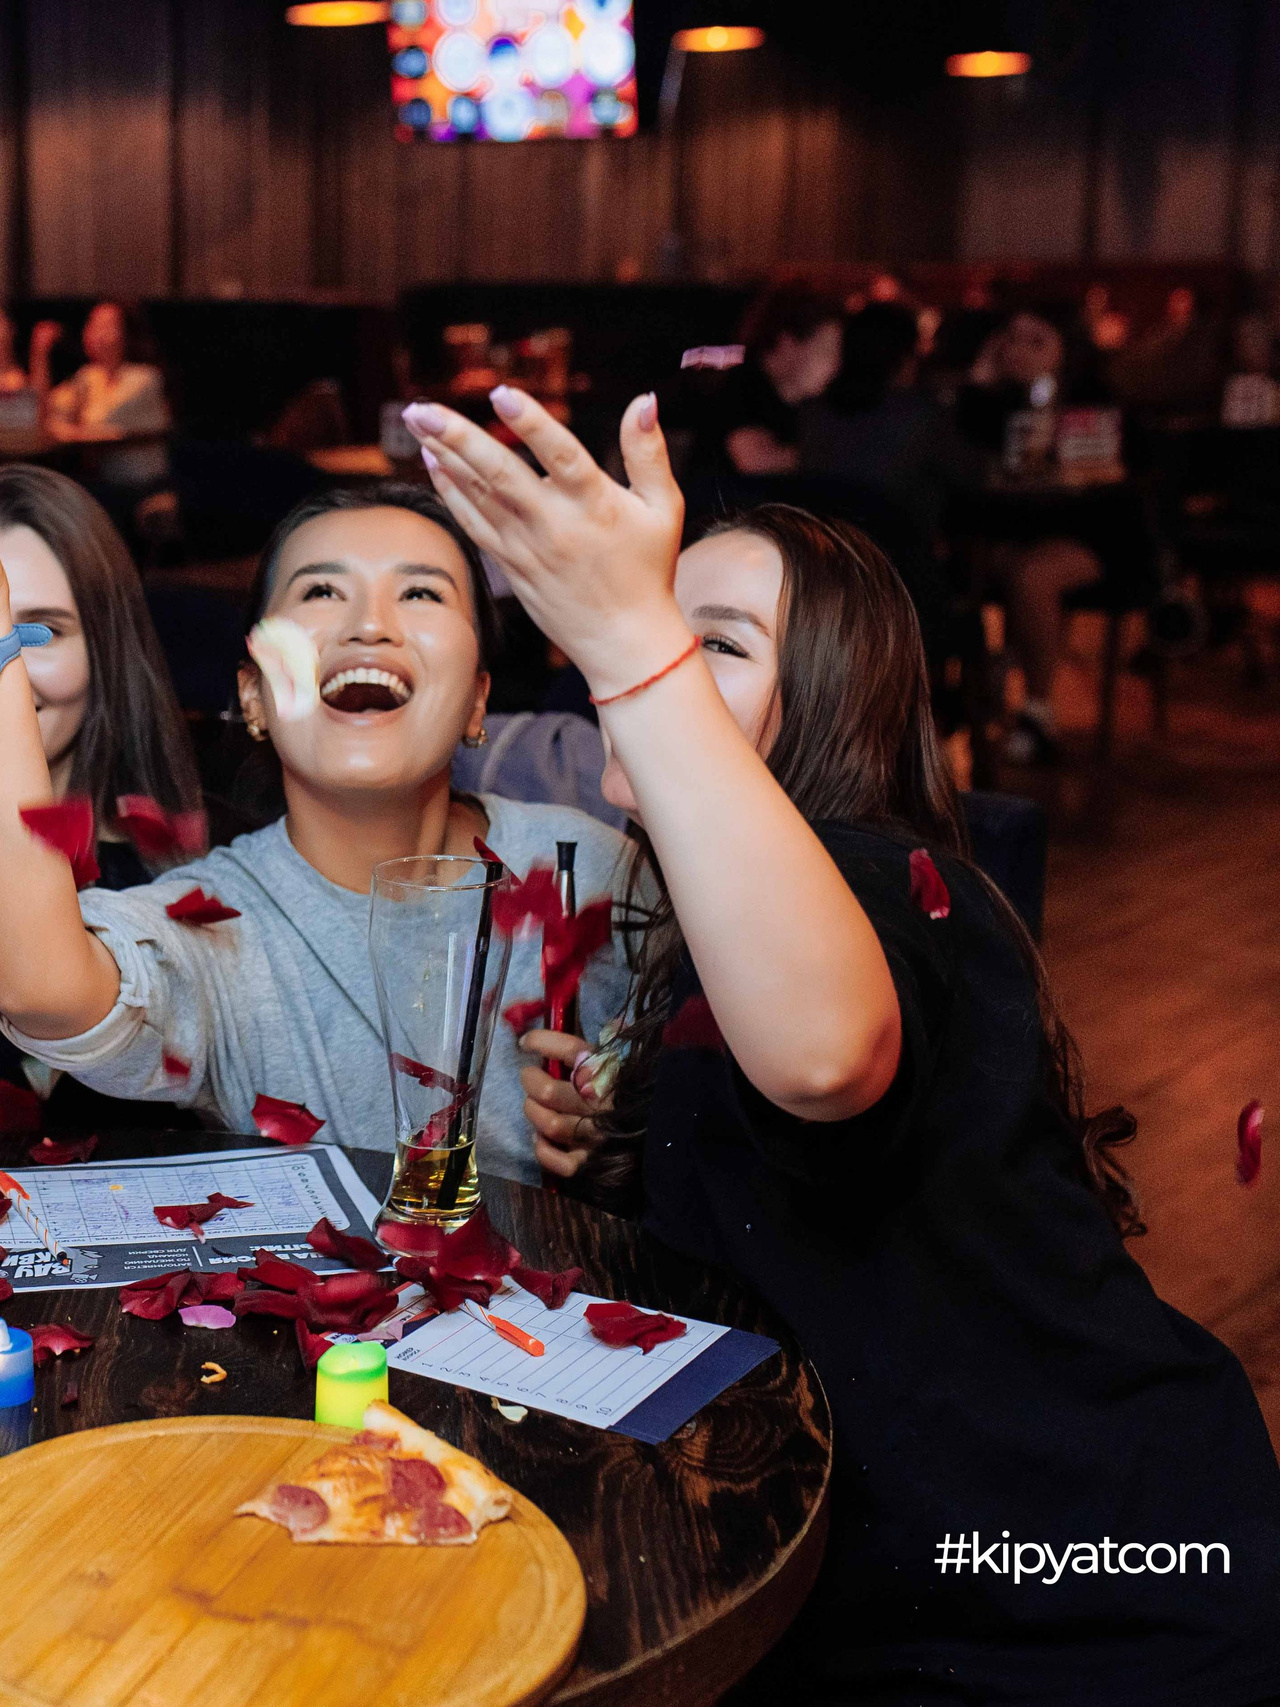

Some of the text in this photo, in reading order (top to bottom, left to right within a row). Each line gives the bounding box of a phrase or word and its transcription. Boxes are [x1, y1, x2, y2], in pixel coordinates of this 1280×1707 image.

[13, 1261, 71, 1279] ВАУ
[123, 1262, 192, 1270] ЗАПОЛНЯЕТСЯ
[595, 1406, 612, 1415] 10
